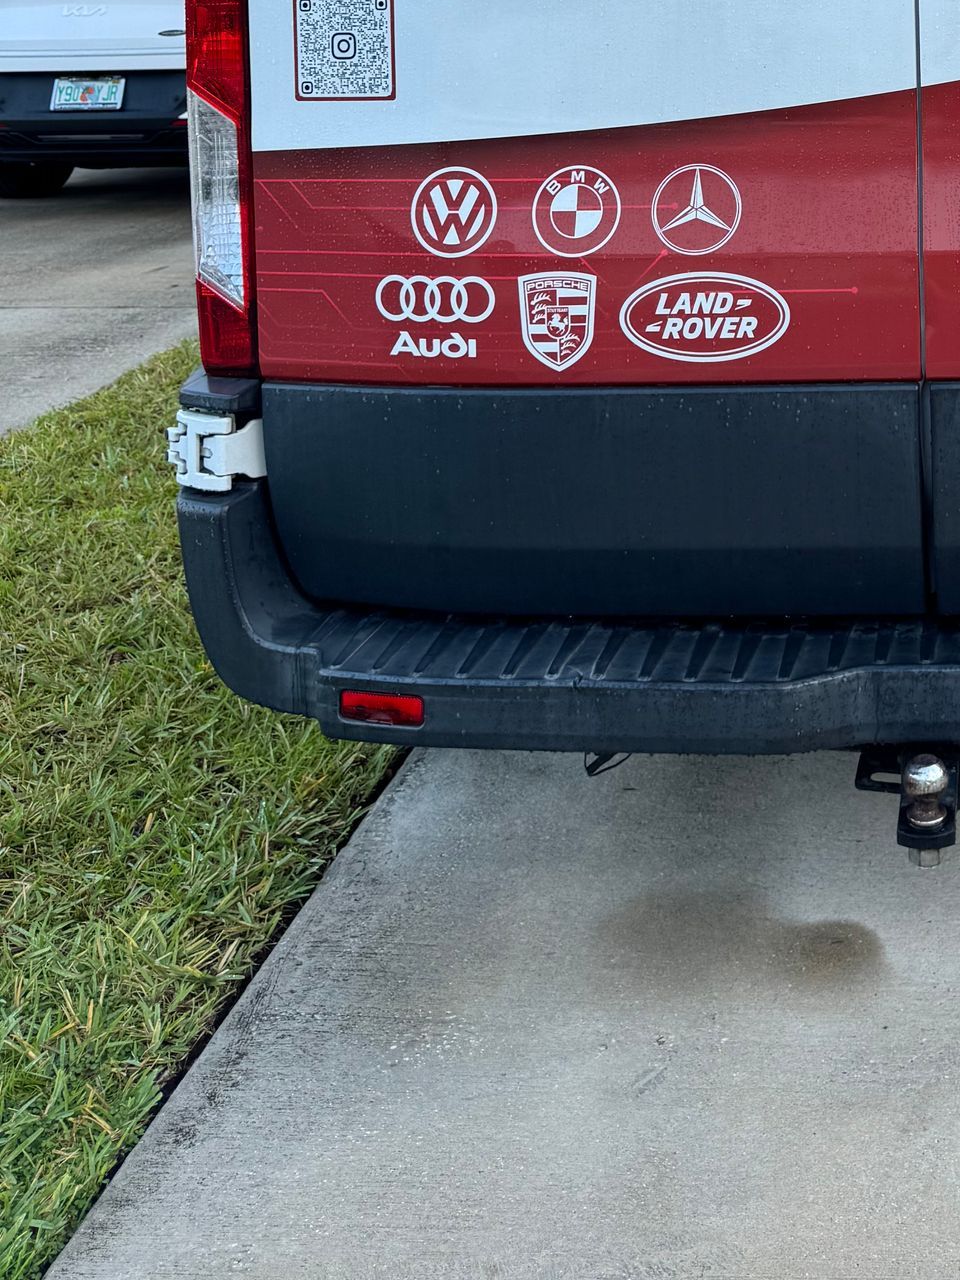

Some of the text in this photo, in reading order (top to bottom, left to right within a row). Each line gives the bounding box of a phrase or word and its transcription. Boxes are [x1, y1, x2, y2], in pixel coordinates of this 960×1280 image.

[546, 170, 610, 195] BMW
[527, 280, 588, 291] PORSCHE
[390, 331, 477, 358] Audi
